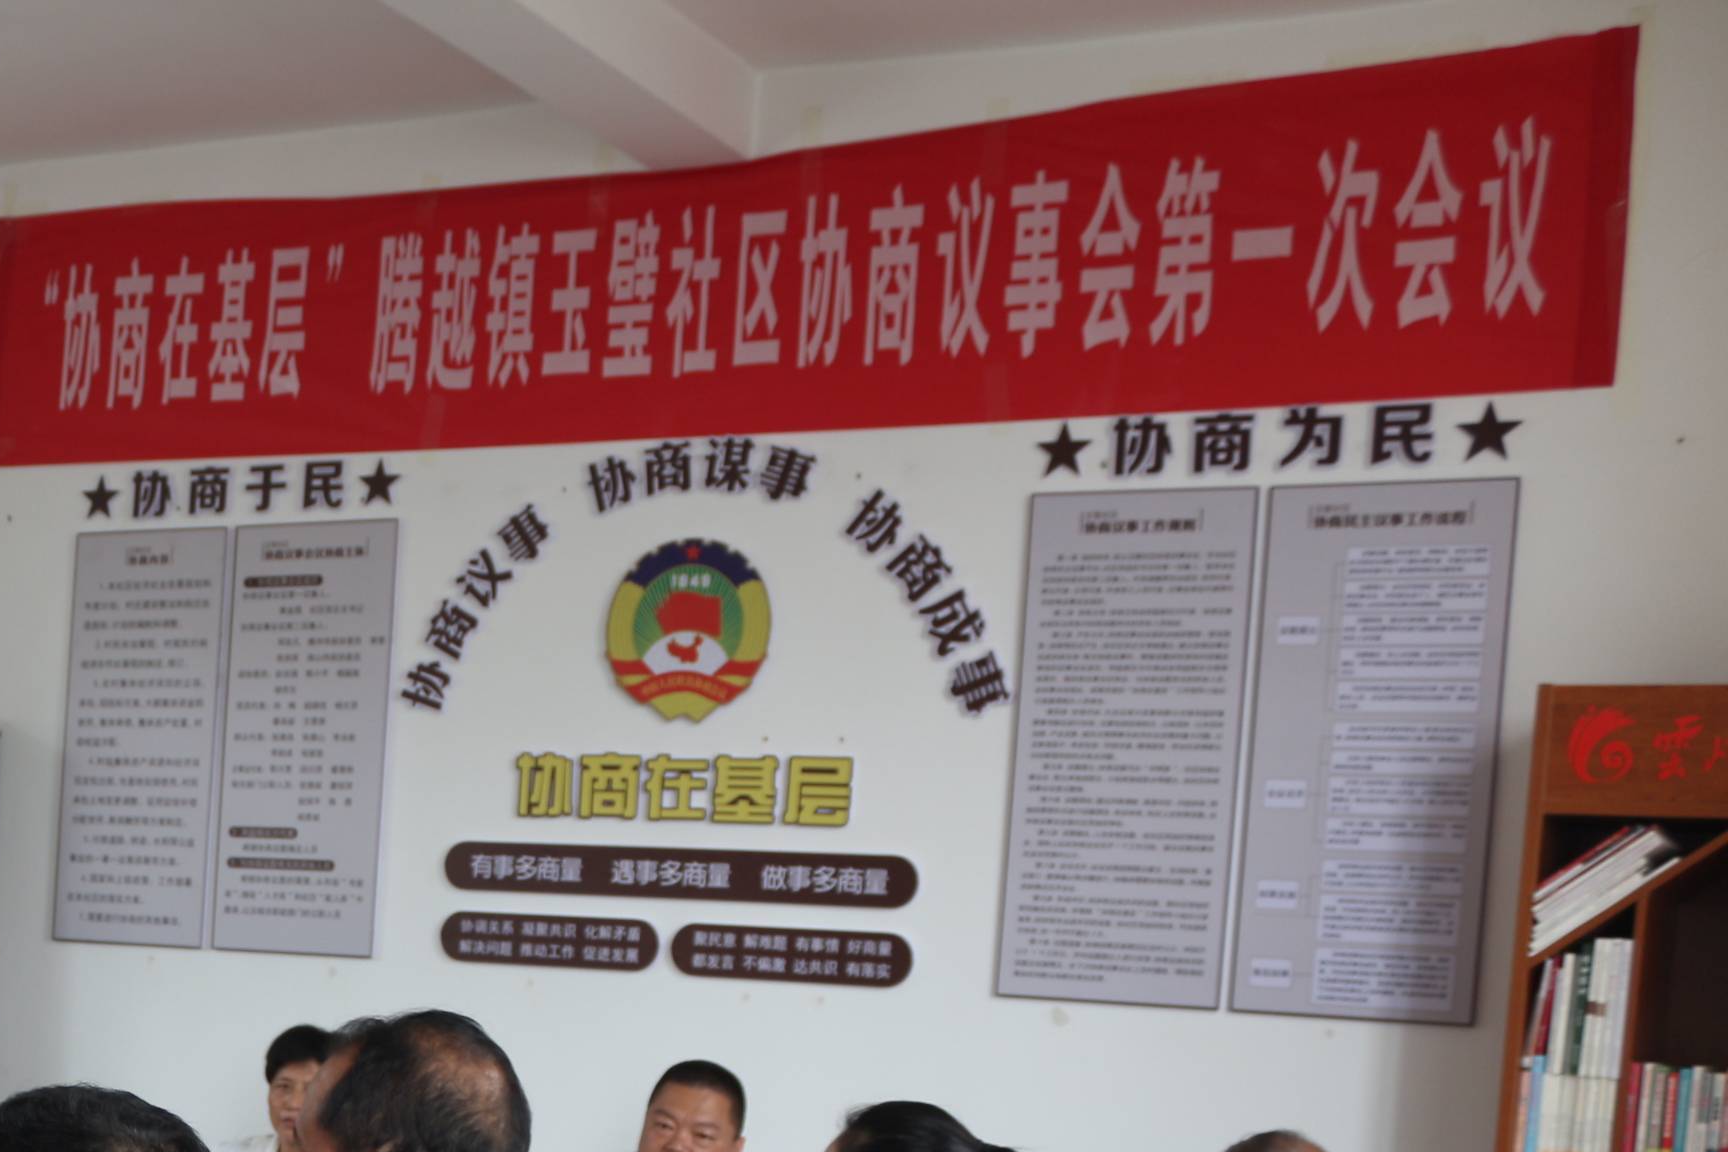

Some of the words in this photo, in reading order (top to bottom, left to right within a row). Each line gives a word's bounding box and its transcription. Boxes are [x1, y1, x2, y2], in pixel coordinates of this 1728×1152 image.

[43, 245, 344, 411] “协商在基层”
[368, 116, 1552, 396] 腾越镇玉璧社区协商议事会第一次会议
[587, 437, 818, 513] 协商谋事
[1112, 403, 1436, 477] 协商为民
[131, 460, 345, 519] 协商于民
[401, 504, 549, 712] 协商议事
[843, 489, 1011, 714] 协商成事
[515, 752, 854, 827] 协商在基层
[470, 854, 583, 883] 有事多商量
[610, 859, 731, 889] 遇事多商量
[760, 864, 890, 896] 做事多商量
